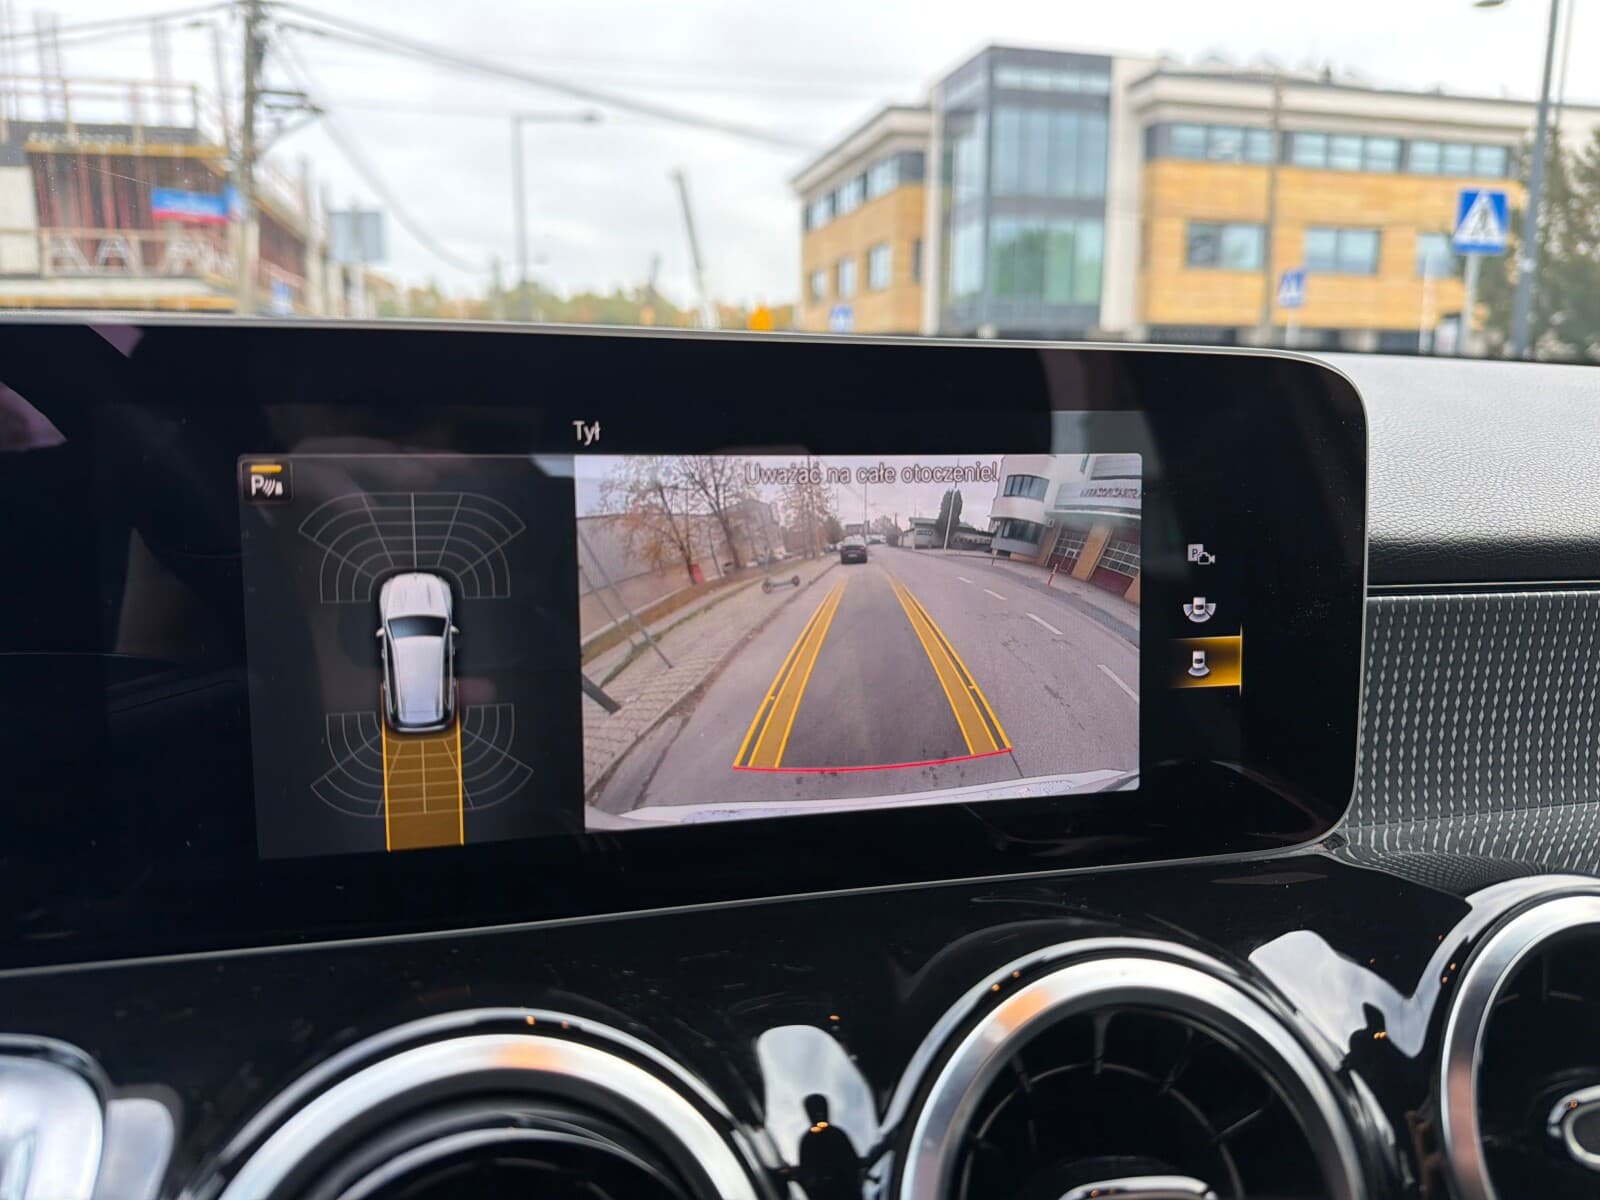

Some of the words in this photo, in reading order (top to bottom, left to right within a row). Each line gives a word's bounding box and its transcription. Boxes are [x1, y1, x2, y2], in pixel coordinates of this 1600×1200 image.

[572, 420, 600, 446] Tył
[745, 463, 821, 484] Uważać
[826, 468, 850, 484] na
[856, 463, 896, 484] całe
[901, 461, 998, 483] otoczenie!
